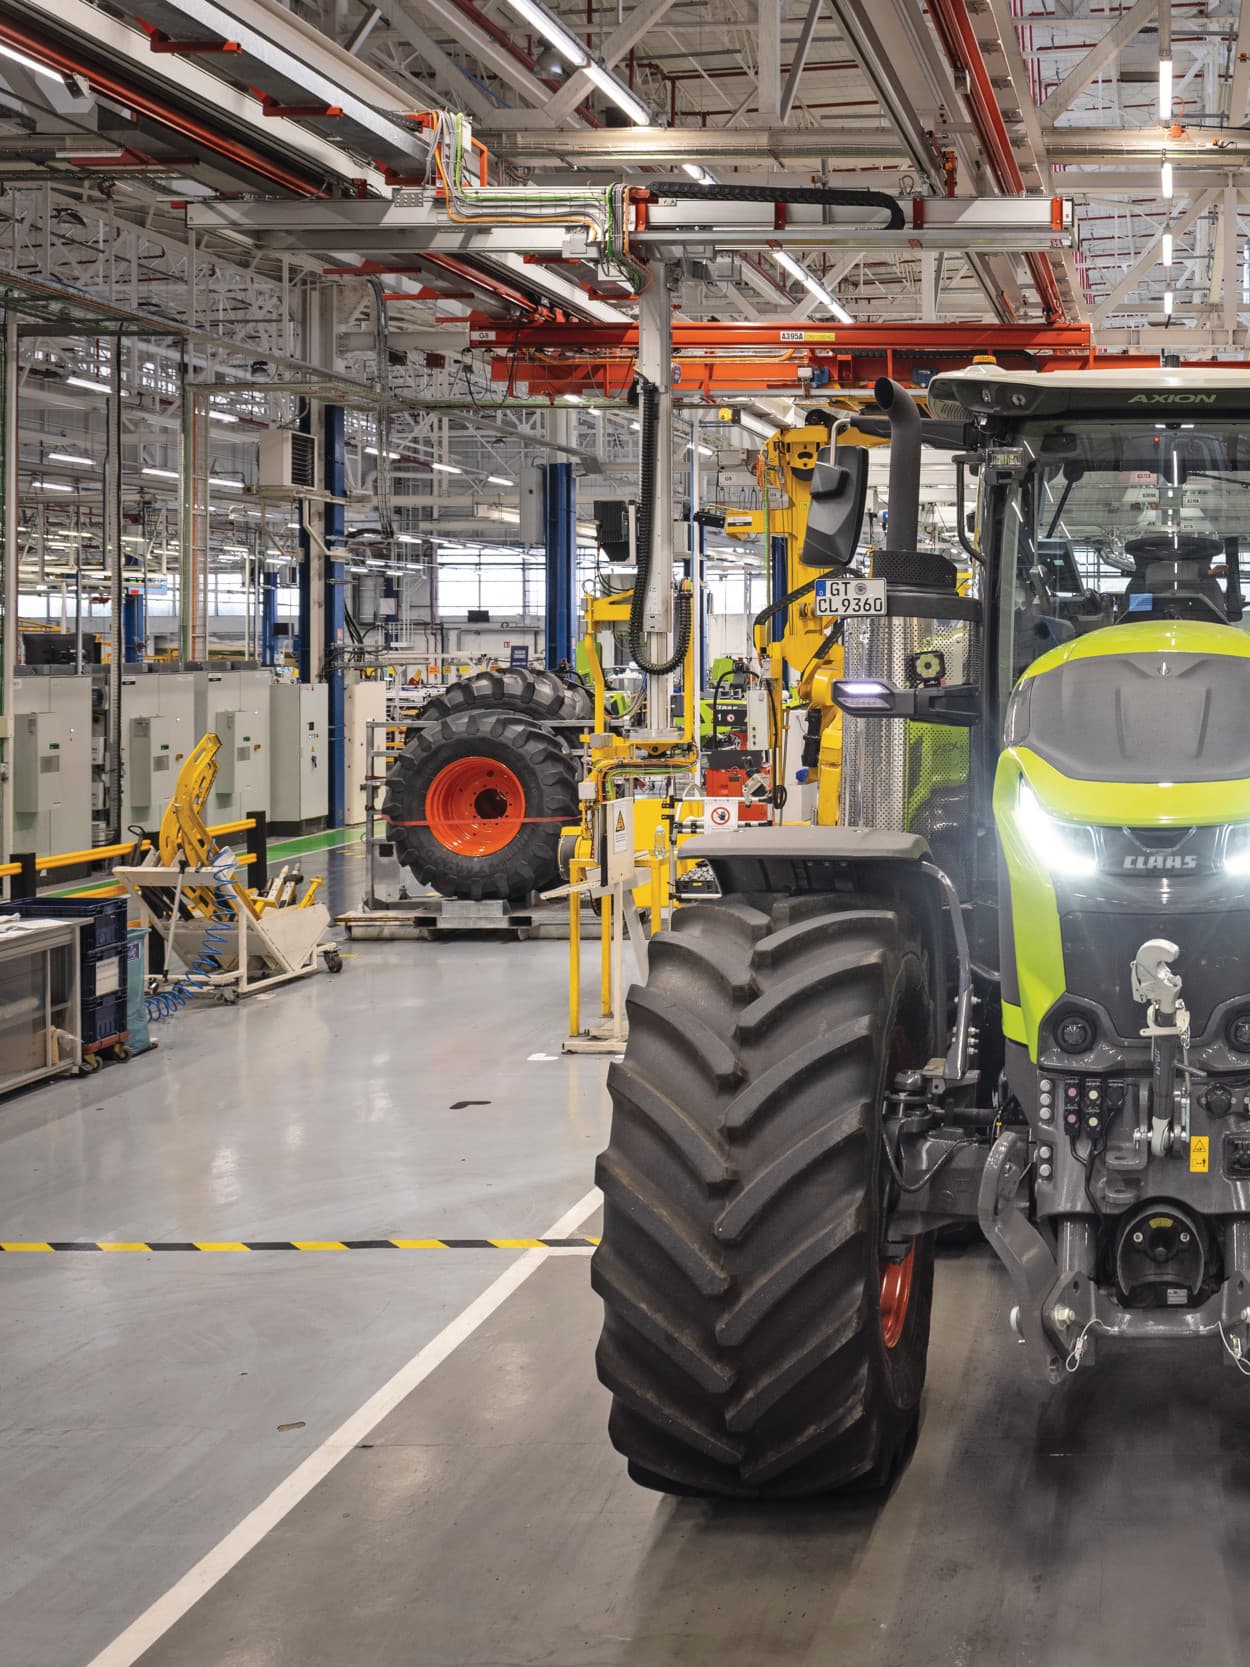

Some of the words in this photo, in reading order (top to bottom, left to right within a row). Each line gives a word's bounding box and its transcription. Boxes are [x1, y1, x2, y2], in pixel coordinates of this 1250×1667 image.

[781, 332, 804, 340] A395A
[1127, 394, 1217, 404] AXION
[830, 582, 851, 597] GT
[818, 598, 839, 613] CL
[841, 597, 883, 613] 9360
[1123, 855, 1198, 869] CLAAS
